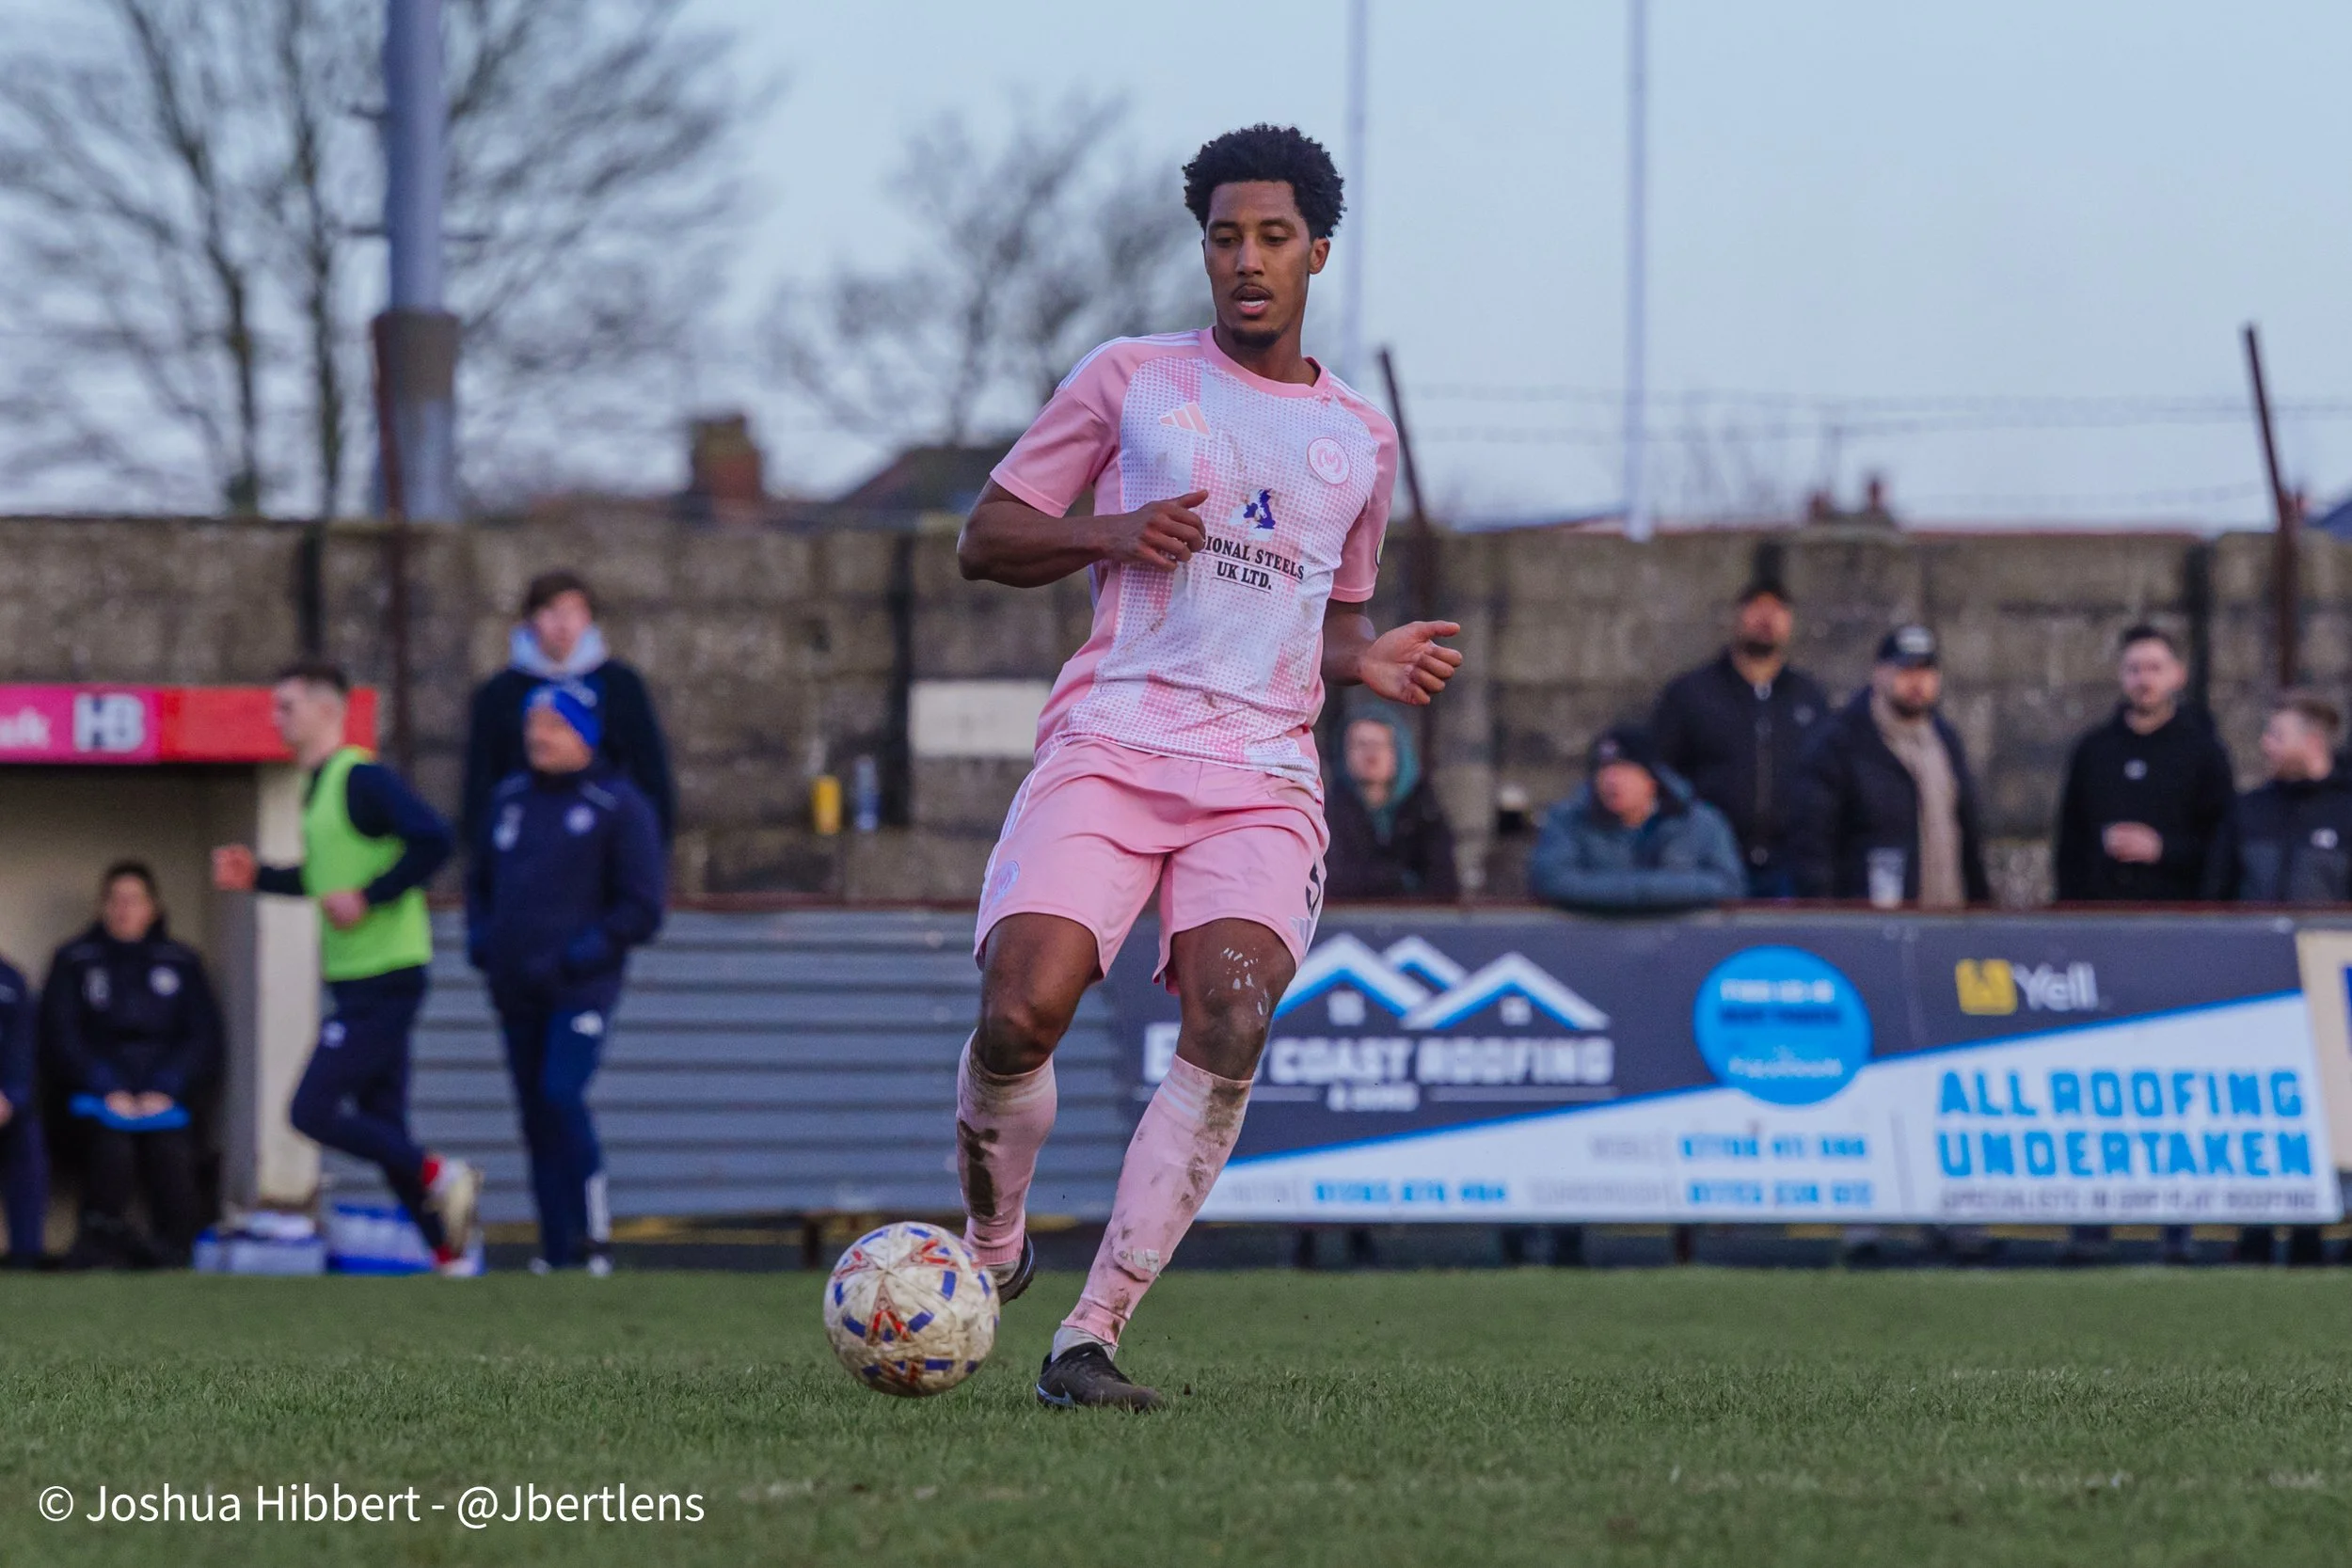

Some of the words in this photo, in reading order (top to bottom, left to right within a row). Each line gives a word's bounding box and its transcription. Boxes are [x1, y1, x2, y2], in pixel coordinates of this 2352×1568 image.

[1203, 535, 1250, 562] IONAL
[1255, 548, 1305, 580] STEELS
[1216, 561, 1239, 580] UK
[1241, 566, 1272, 590] LTD.
[73, 692, 145, 752] HB
[2012, 961, 2099, 1012] Yell
[1937, 1069, 2039, 1118] ALL
[2048, 1069, 2304, 1119] ROOFING
[1936, 1128, 2313, 1180] UNDERTAKEN
